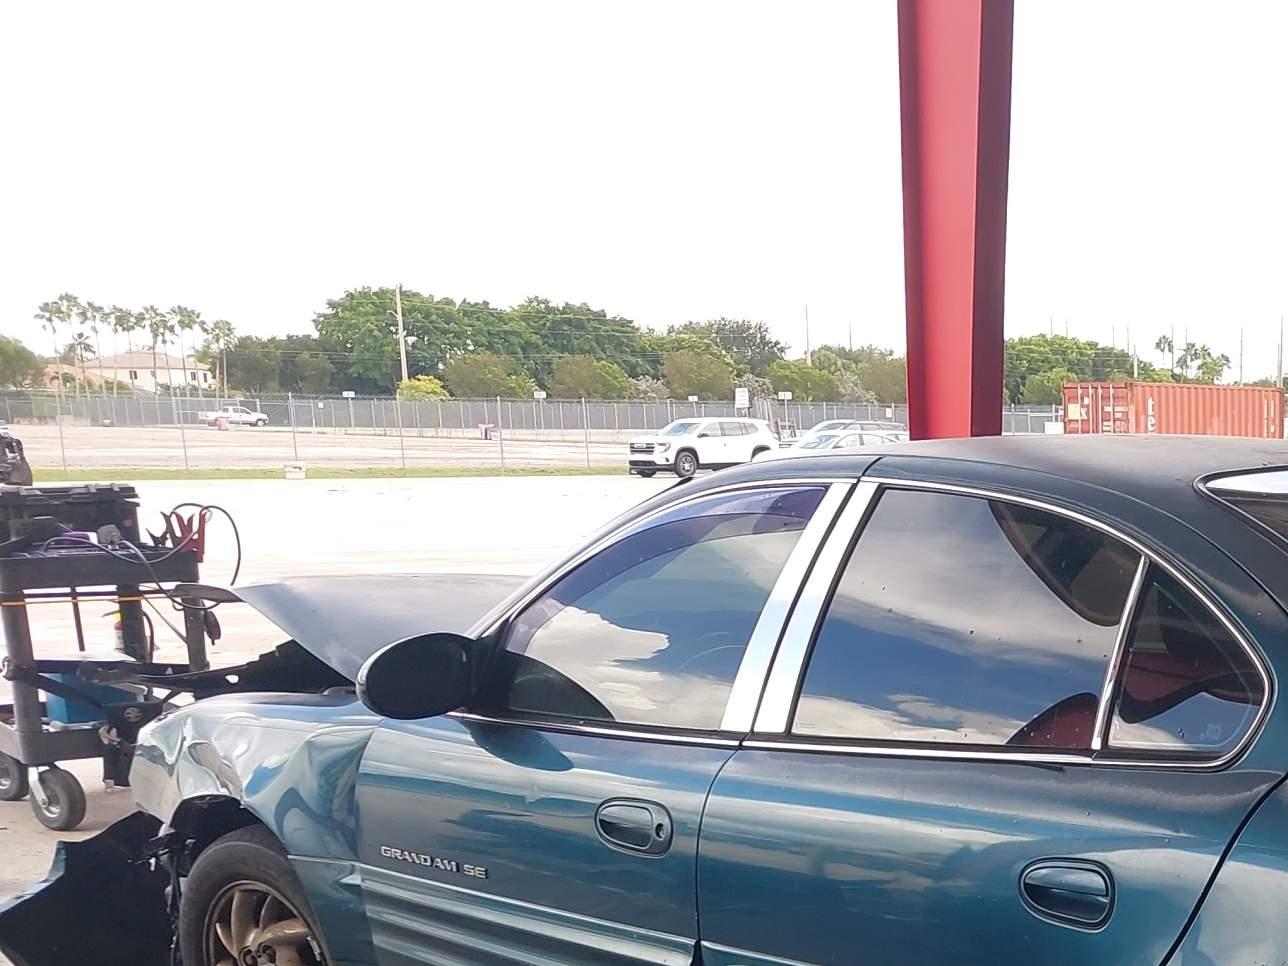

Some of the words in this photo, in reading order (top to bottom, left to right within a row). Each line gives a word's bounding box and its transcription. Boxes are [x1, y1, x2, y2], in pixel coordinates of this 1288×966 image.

[380, 845, 432, 867] GRAND
[432, 857, 459, 873] AM
[463, 863, 488, 880] SE
